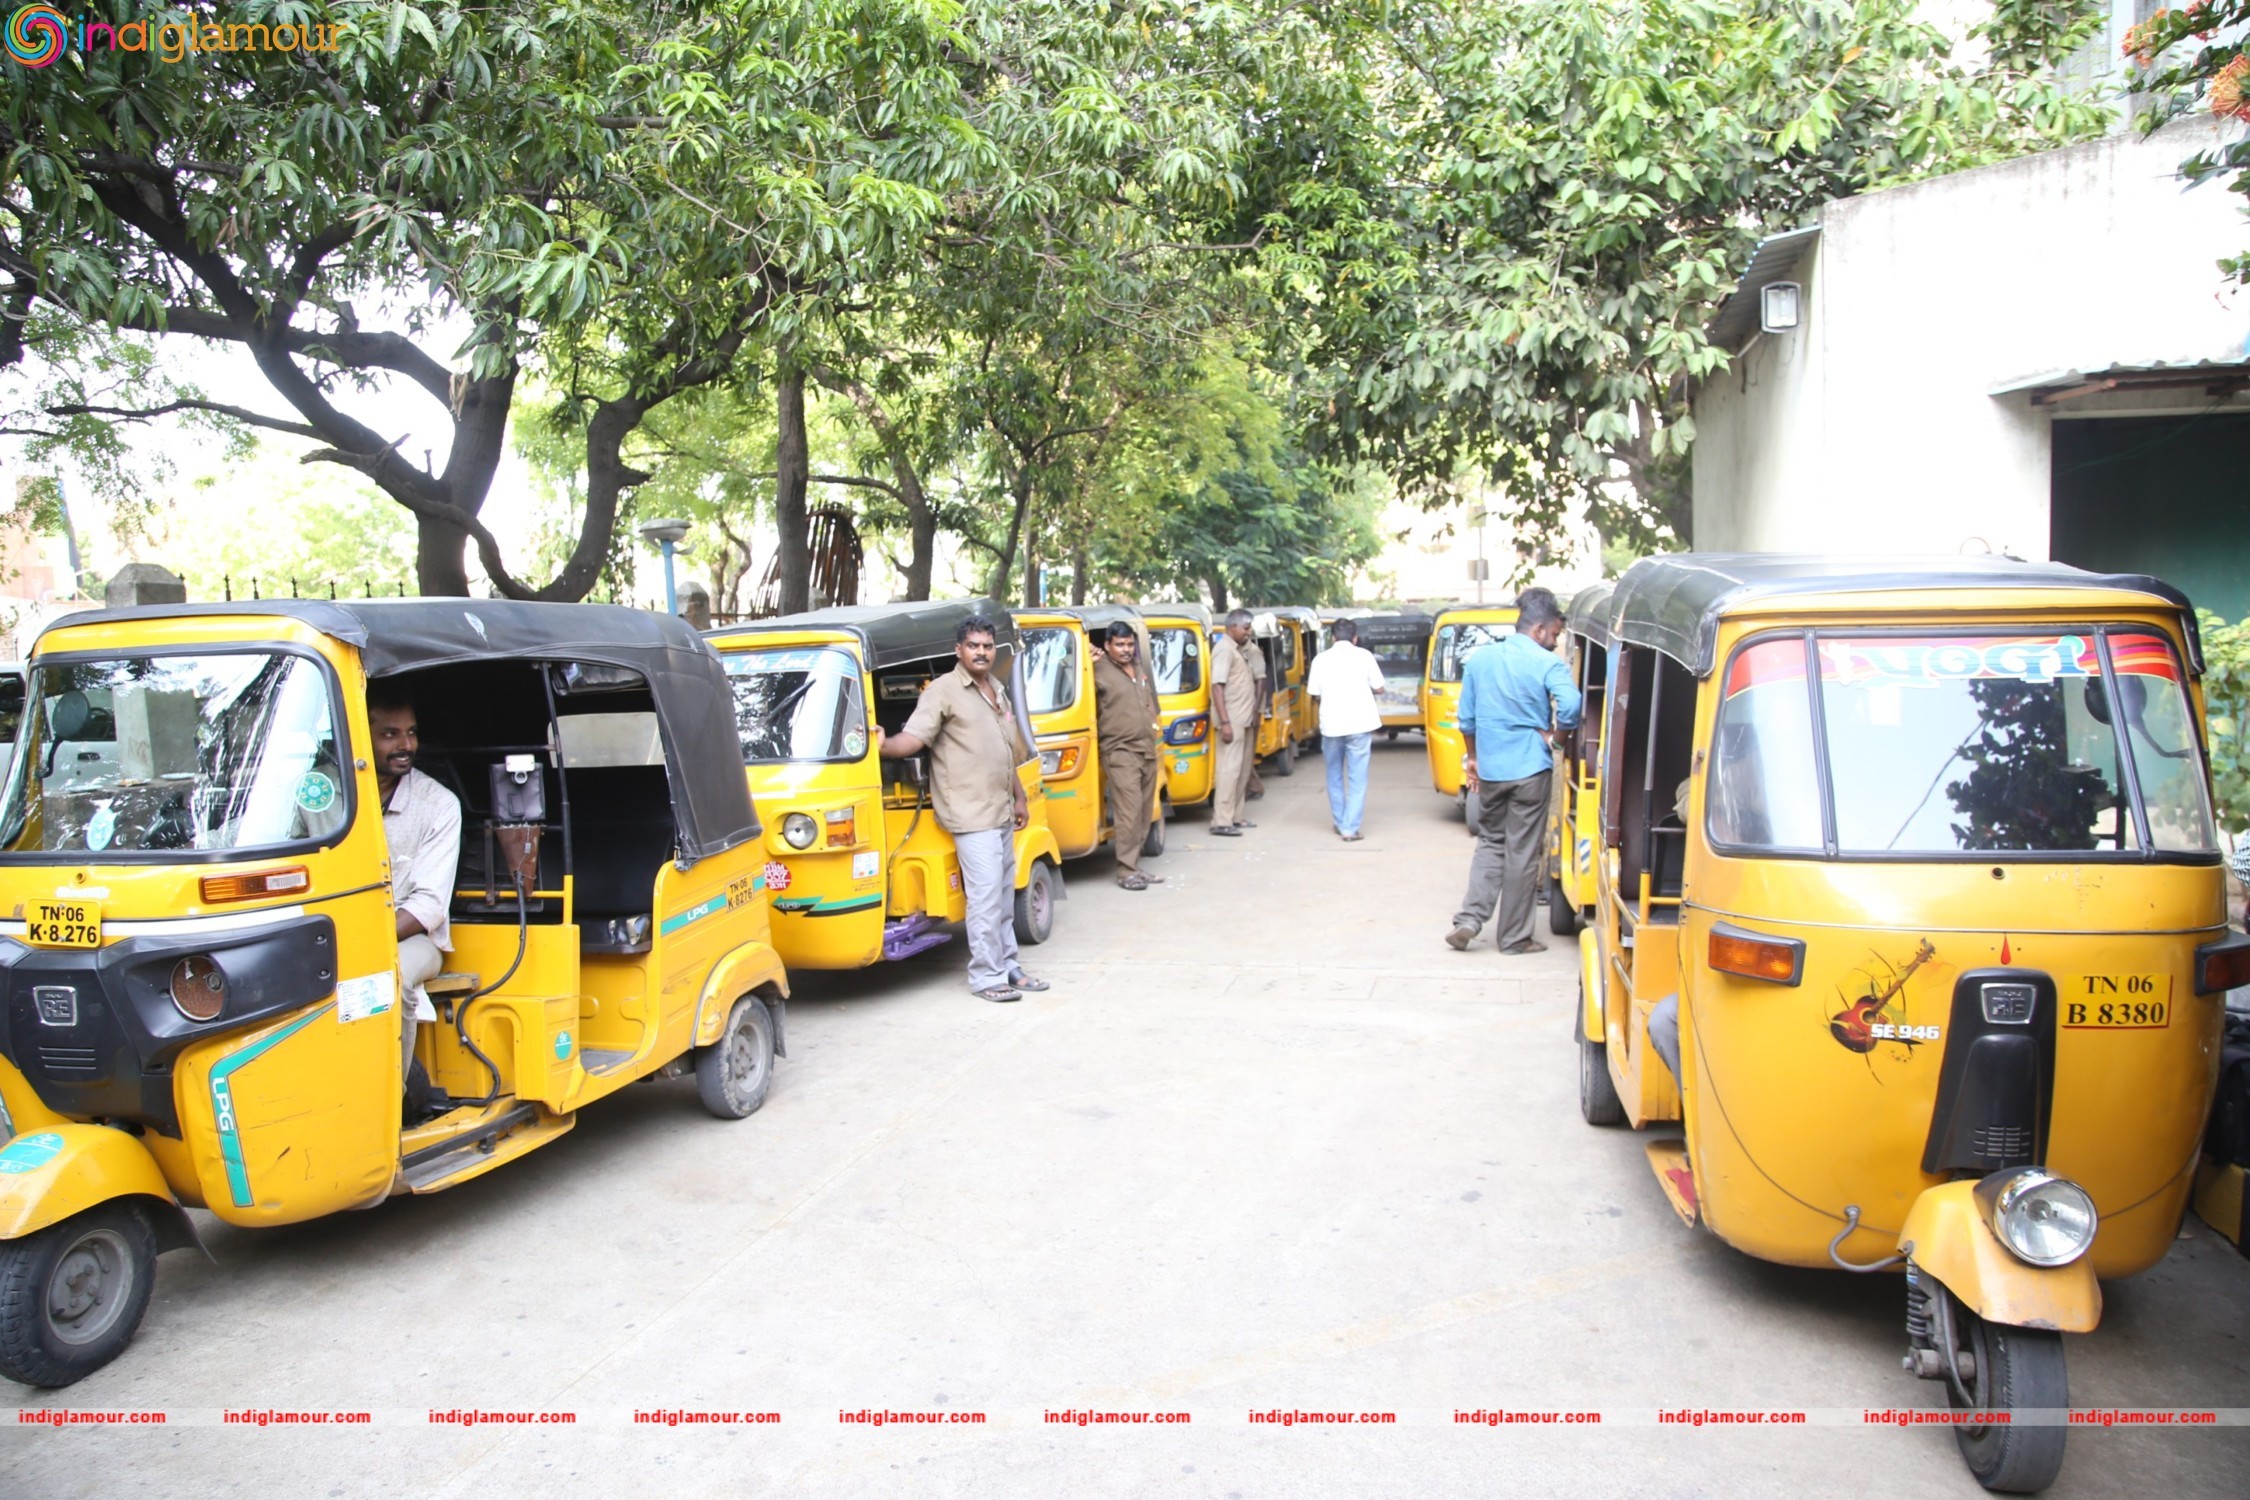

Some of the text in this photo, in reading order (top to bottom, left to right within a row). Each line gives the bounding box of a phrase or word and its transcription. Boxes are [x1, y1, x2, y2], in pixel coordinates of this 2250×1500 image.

[687, 903, 709, 920] LPG
[2083, 974, 2154, 994] TN 06
[2067, 1002, 2165, 1025] B 8380
[1871, 1023, 1940, 1040] SE 946
[212, 1077, 235, 1131] LPG
